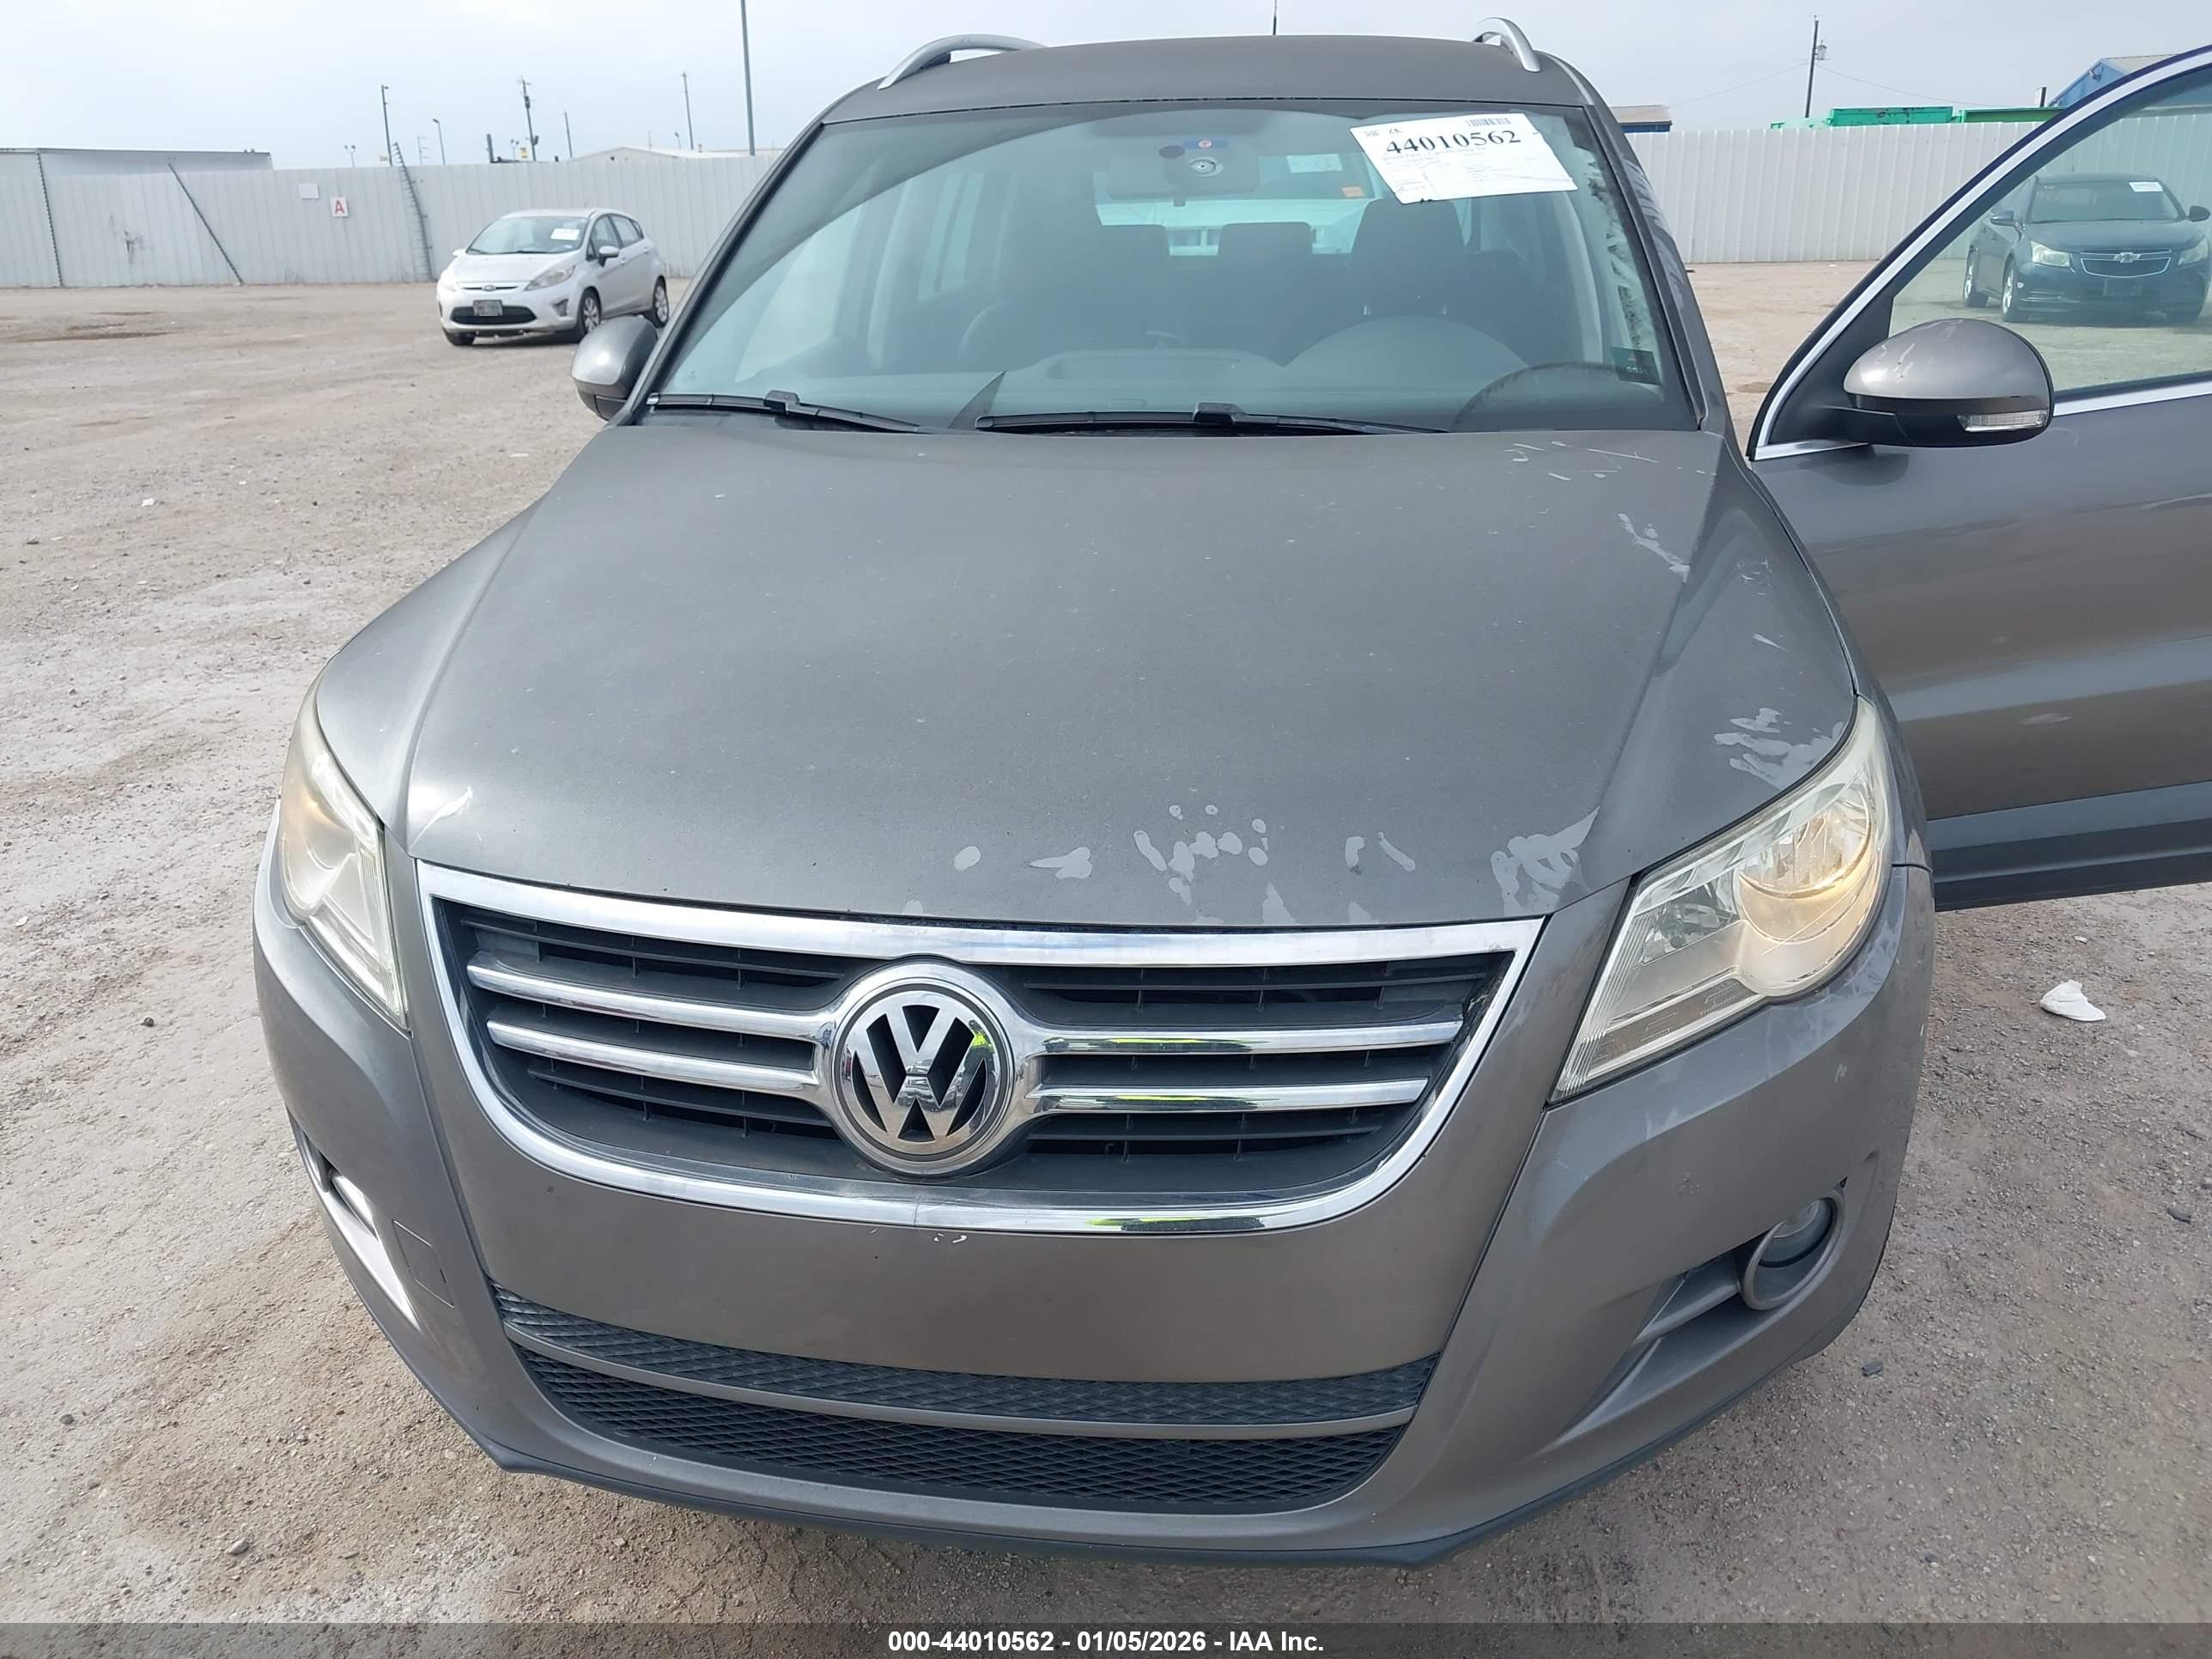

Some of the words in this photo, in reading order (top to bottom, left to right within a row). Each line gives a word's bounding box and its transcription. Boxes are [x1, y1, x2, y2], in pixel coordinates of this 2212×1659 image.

[1386, 130, 1522, 154] 44010562
[335, 199, 345, 215] A
[843, 991, 996, 1156] VW
